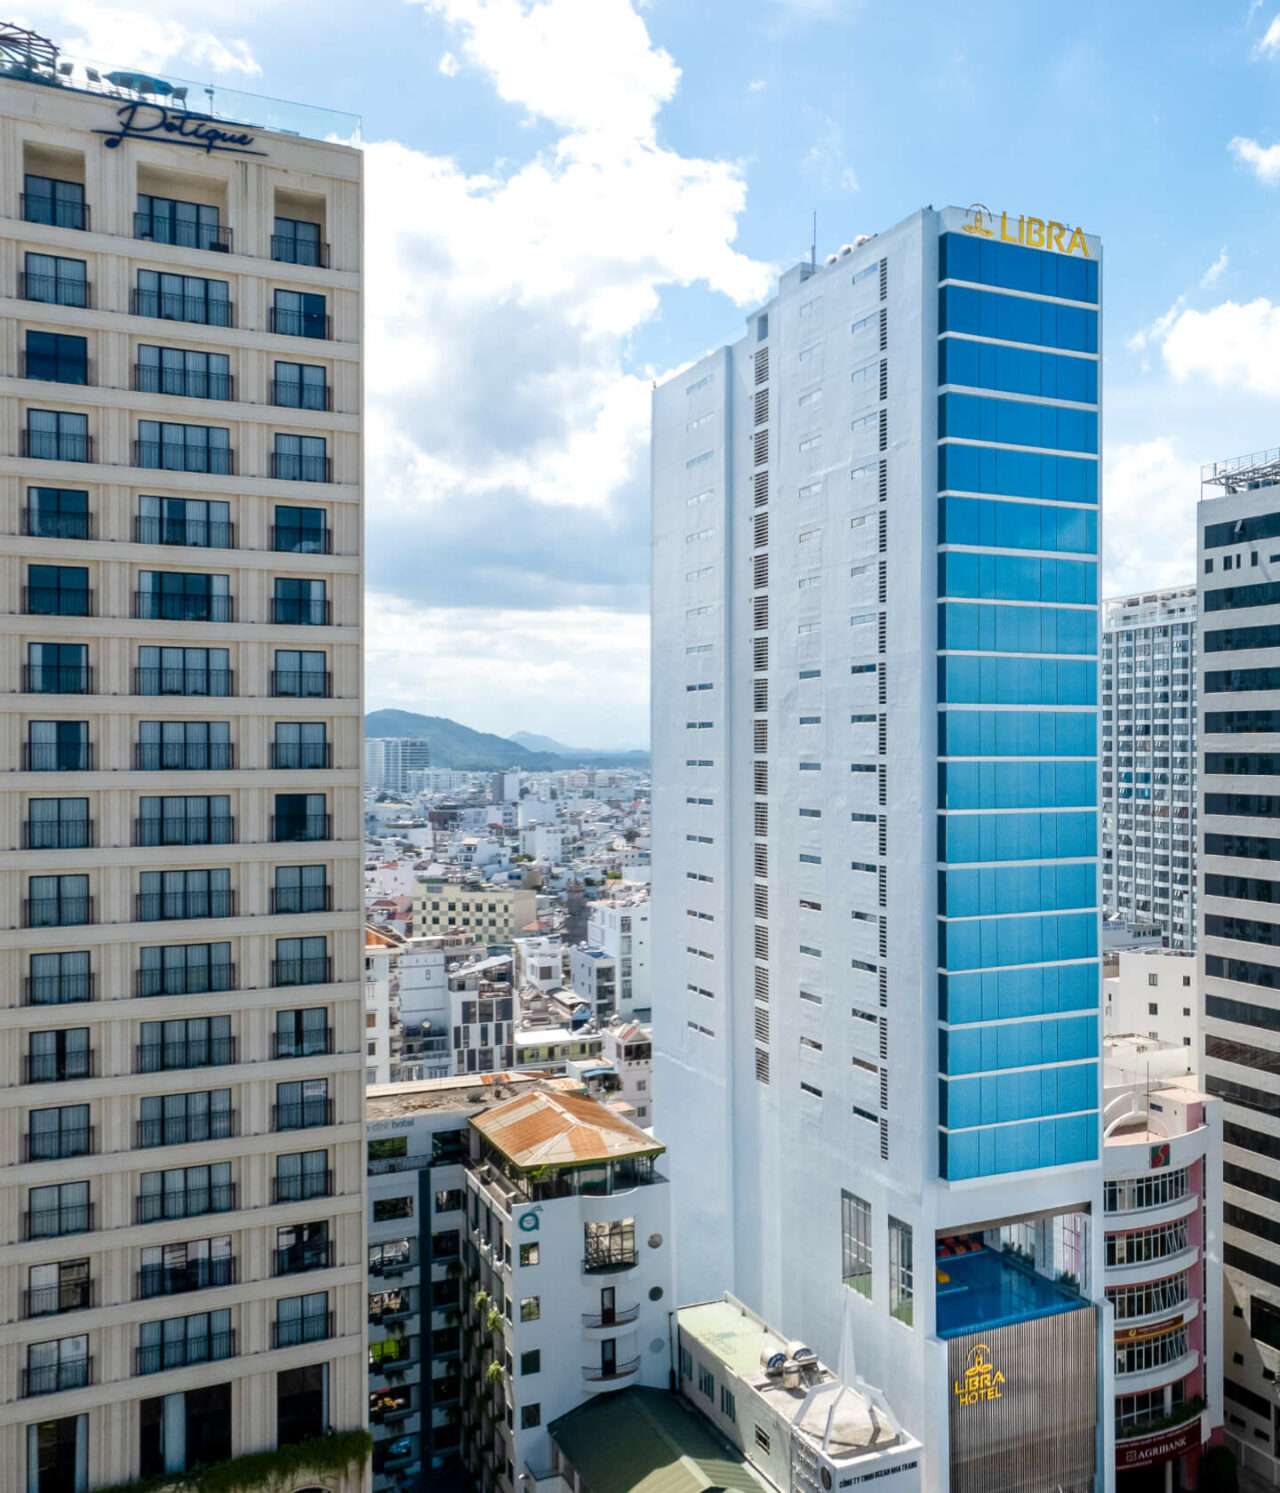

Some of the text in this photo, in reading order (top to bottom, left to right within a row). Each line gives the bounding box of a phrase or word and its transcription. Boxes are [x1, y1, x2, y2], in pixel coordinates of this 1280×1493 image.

[1001, 211, 1090, 257] LIBRA
[954, 1370, 1006, 1395] LIBRA
[959, 1386, 1003, 1408] HOTEL
[1138, 1436, 1187, 1460] AGRIBANK
